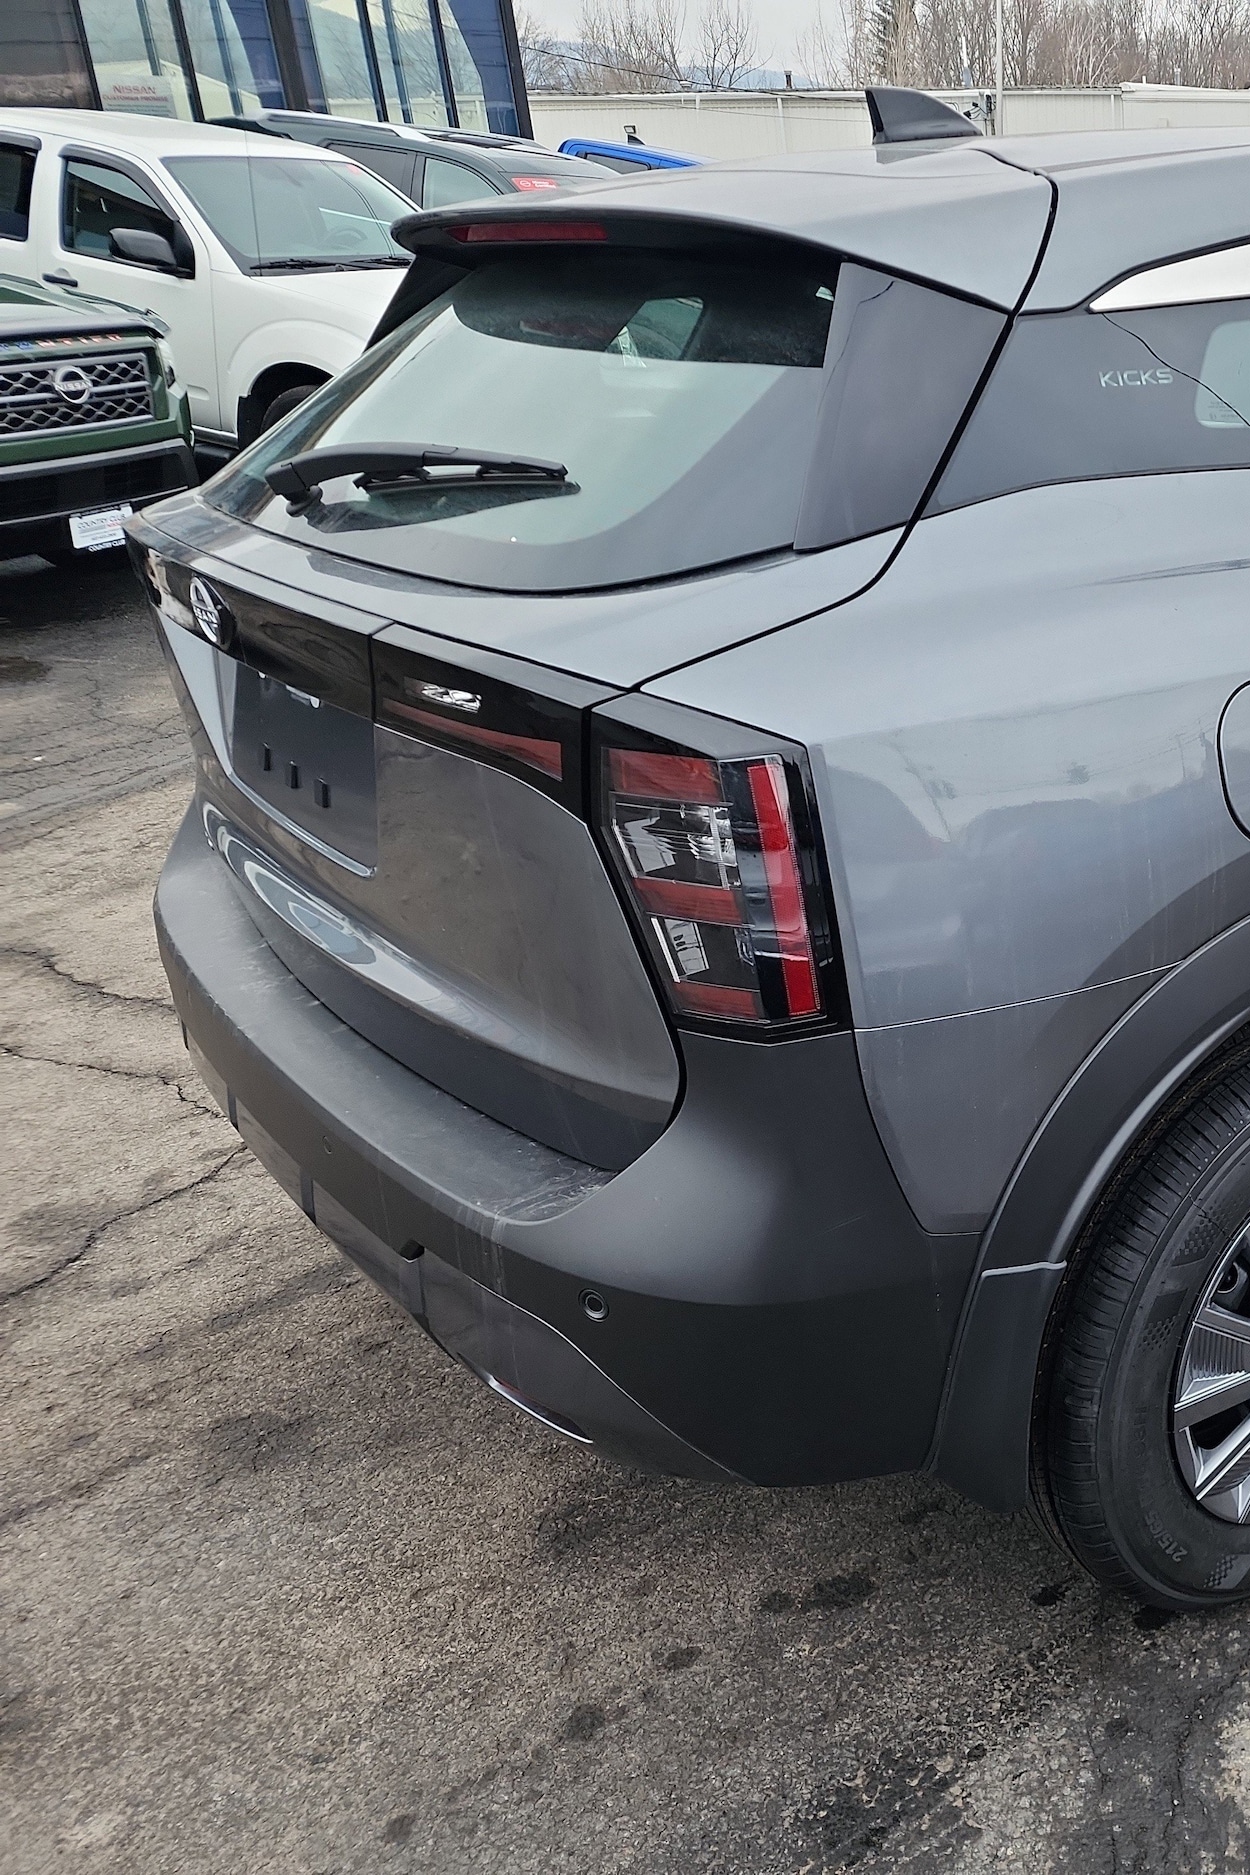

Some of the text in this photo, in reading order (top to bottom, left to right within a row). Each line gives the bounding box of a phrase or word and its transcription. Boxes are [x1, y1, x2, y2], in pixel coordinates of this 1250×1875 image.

[112, 84, 156, 95] NISSAN
[1099, 368, 1174, 387] KICKS
[1145, 1511, 1188, 1563] 215/65
